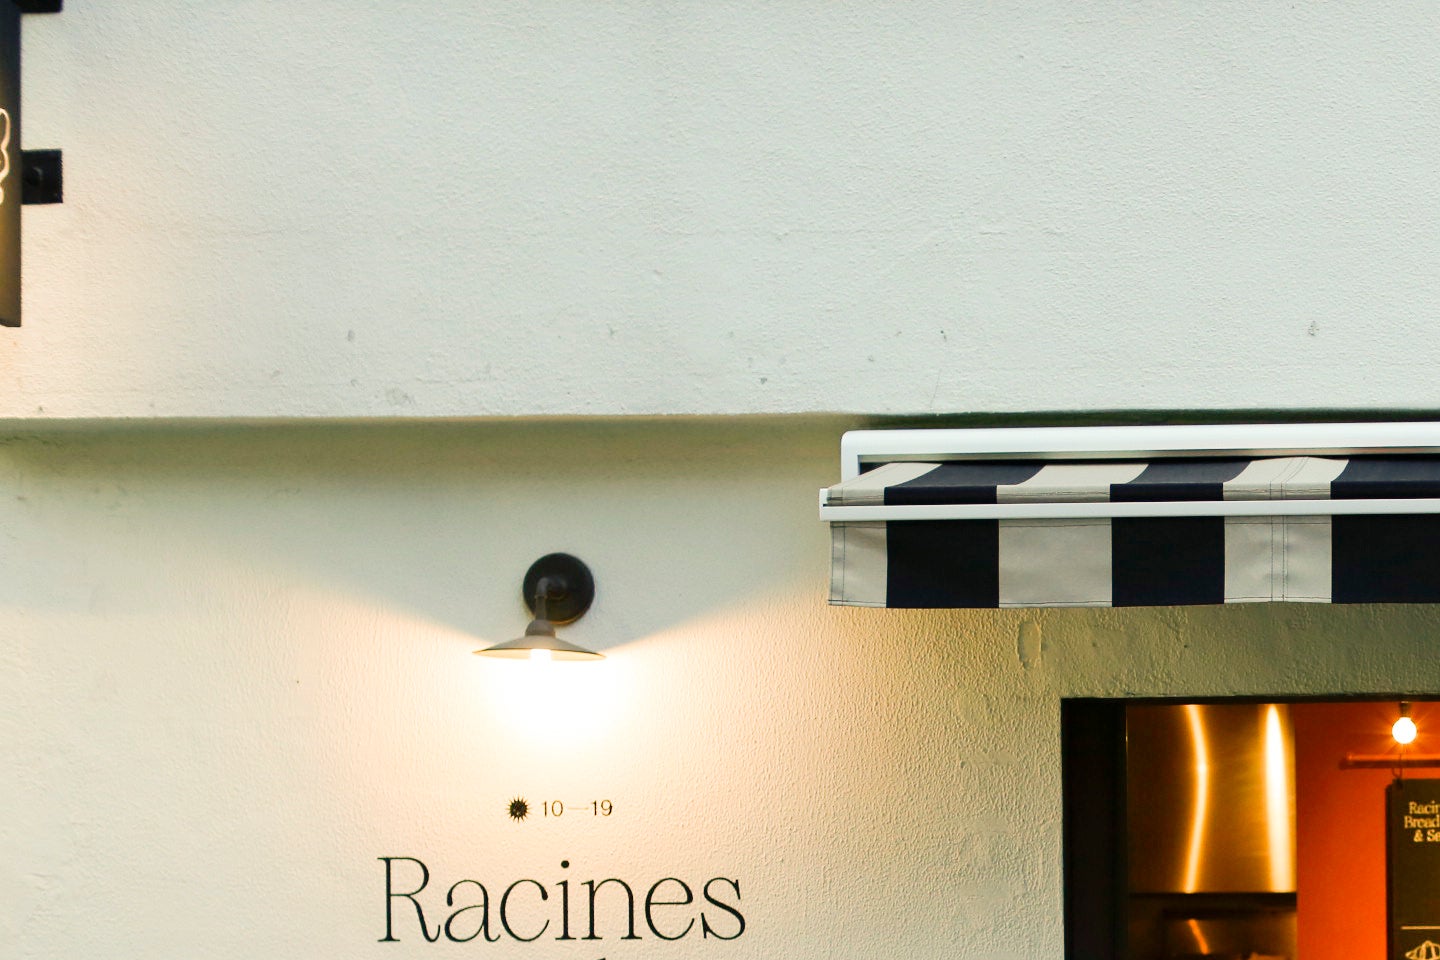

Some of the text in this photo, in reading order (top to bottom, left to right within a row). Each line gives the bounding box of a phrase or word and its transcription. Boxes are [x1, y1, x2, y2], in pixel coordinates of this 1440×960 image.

[1404, 815, 1440, 829] Bread
[1413, 829, 1424, 842] &
[377, 856, 747, 943] Racines
